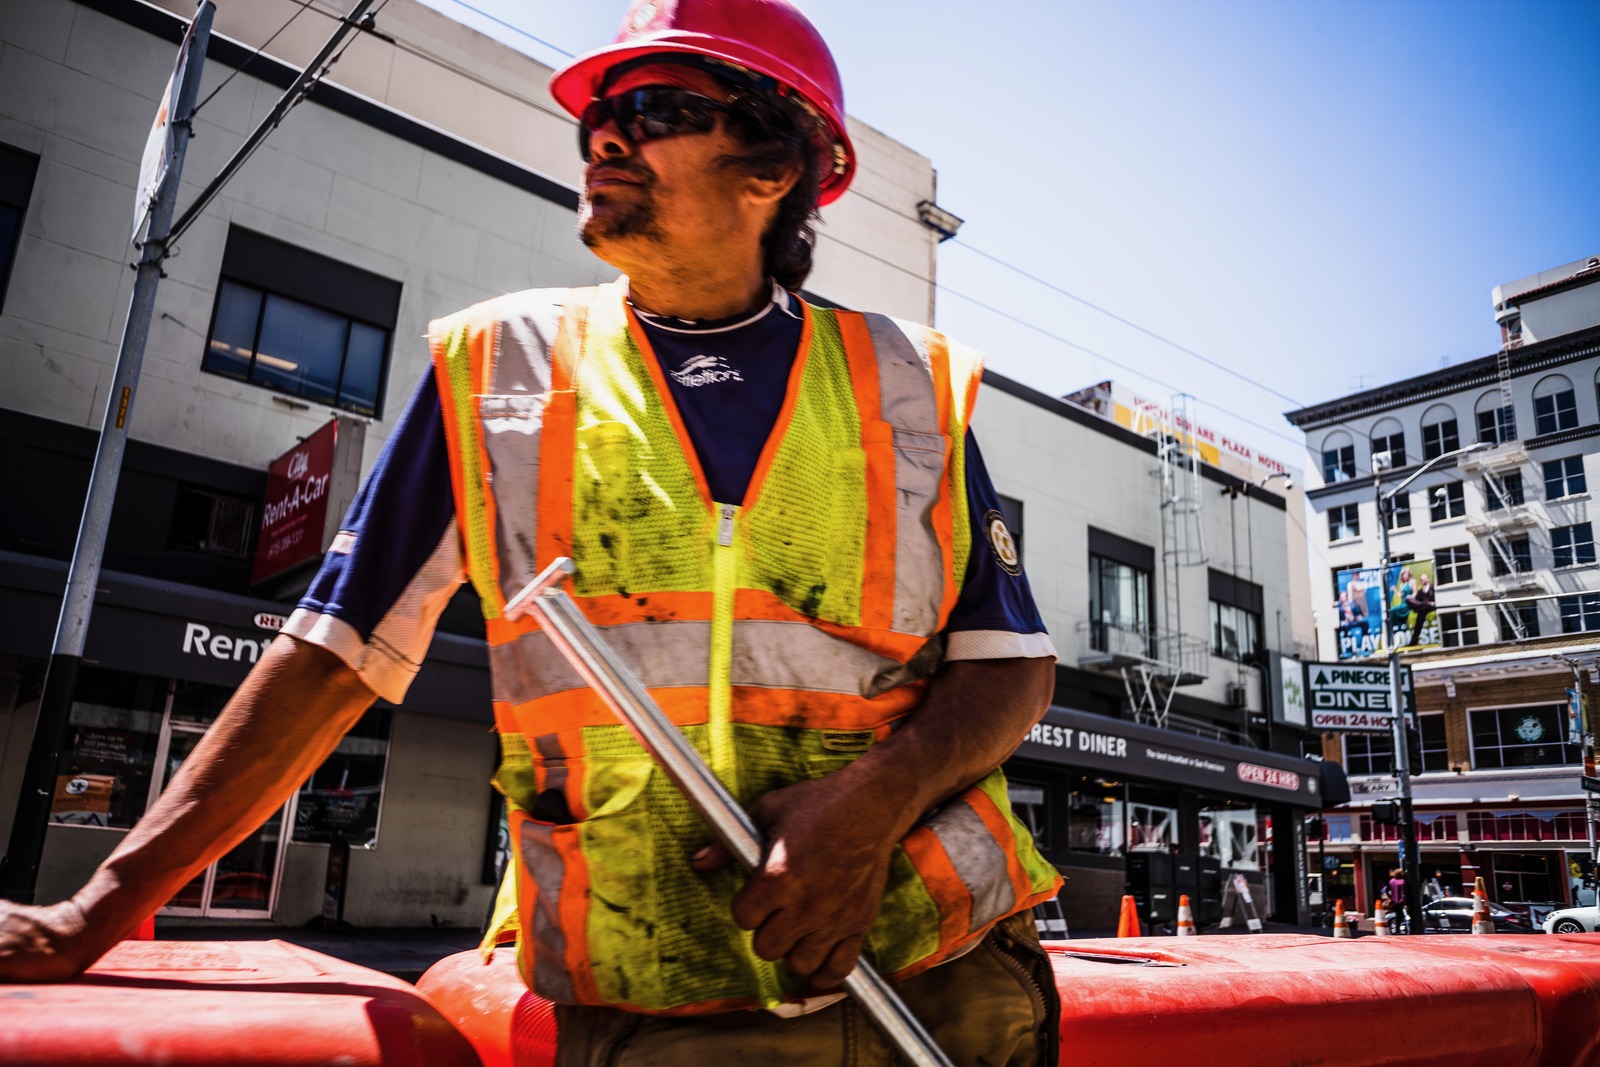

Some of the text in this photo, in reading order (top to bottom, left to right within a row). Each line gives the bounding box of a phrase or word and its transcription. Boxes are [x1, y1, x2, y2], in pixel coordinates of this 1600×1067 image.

[1222, 437, 1251, 459] PLAZA
[1258, 453, 1287, 474] HOTEL
[262, 473, 329, 529] Rent-A-Car
[1341, 626, 1440, 654] PLAYOUSE
[1331, 669, 1408, 686] PINECRET
[1315, 713, 1346, 725] OPEN
[1349, 713, 1369, 725] 24
[1023, 723, 1127, 758] REST DINER
[1240, 763, 1299, 788] OPEN 24 HRS
